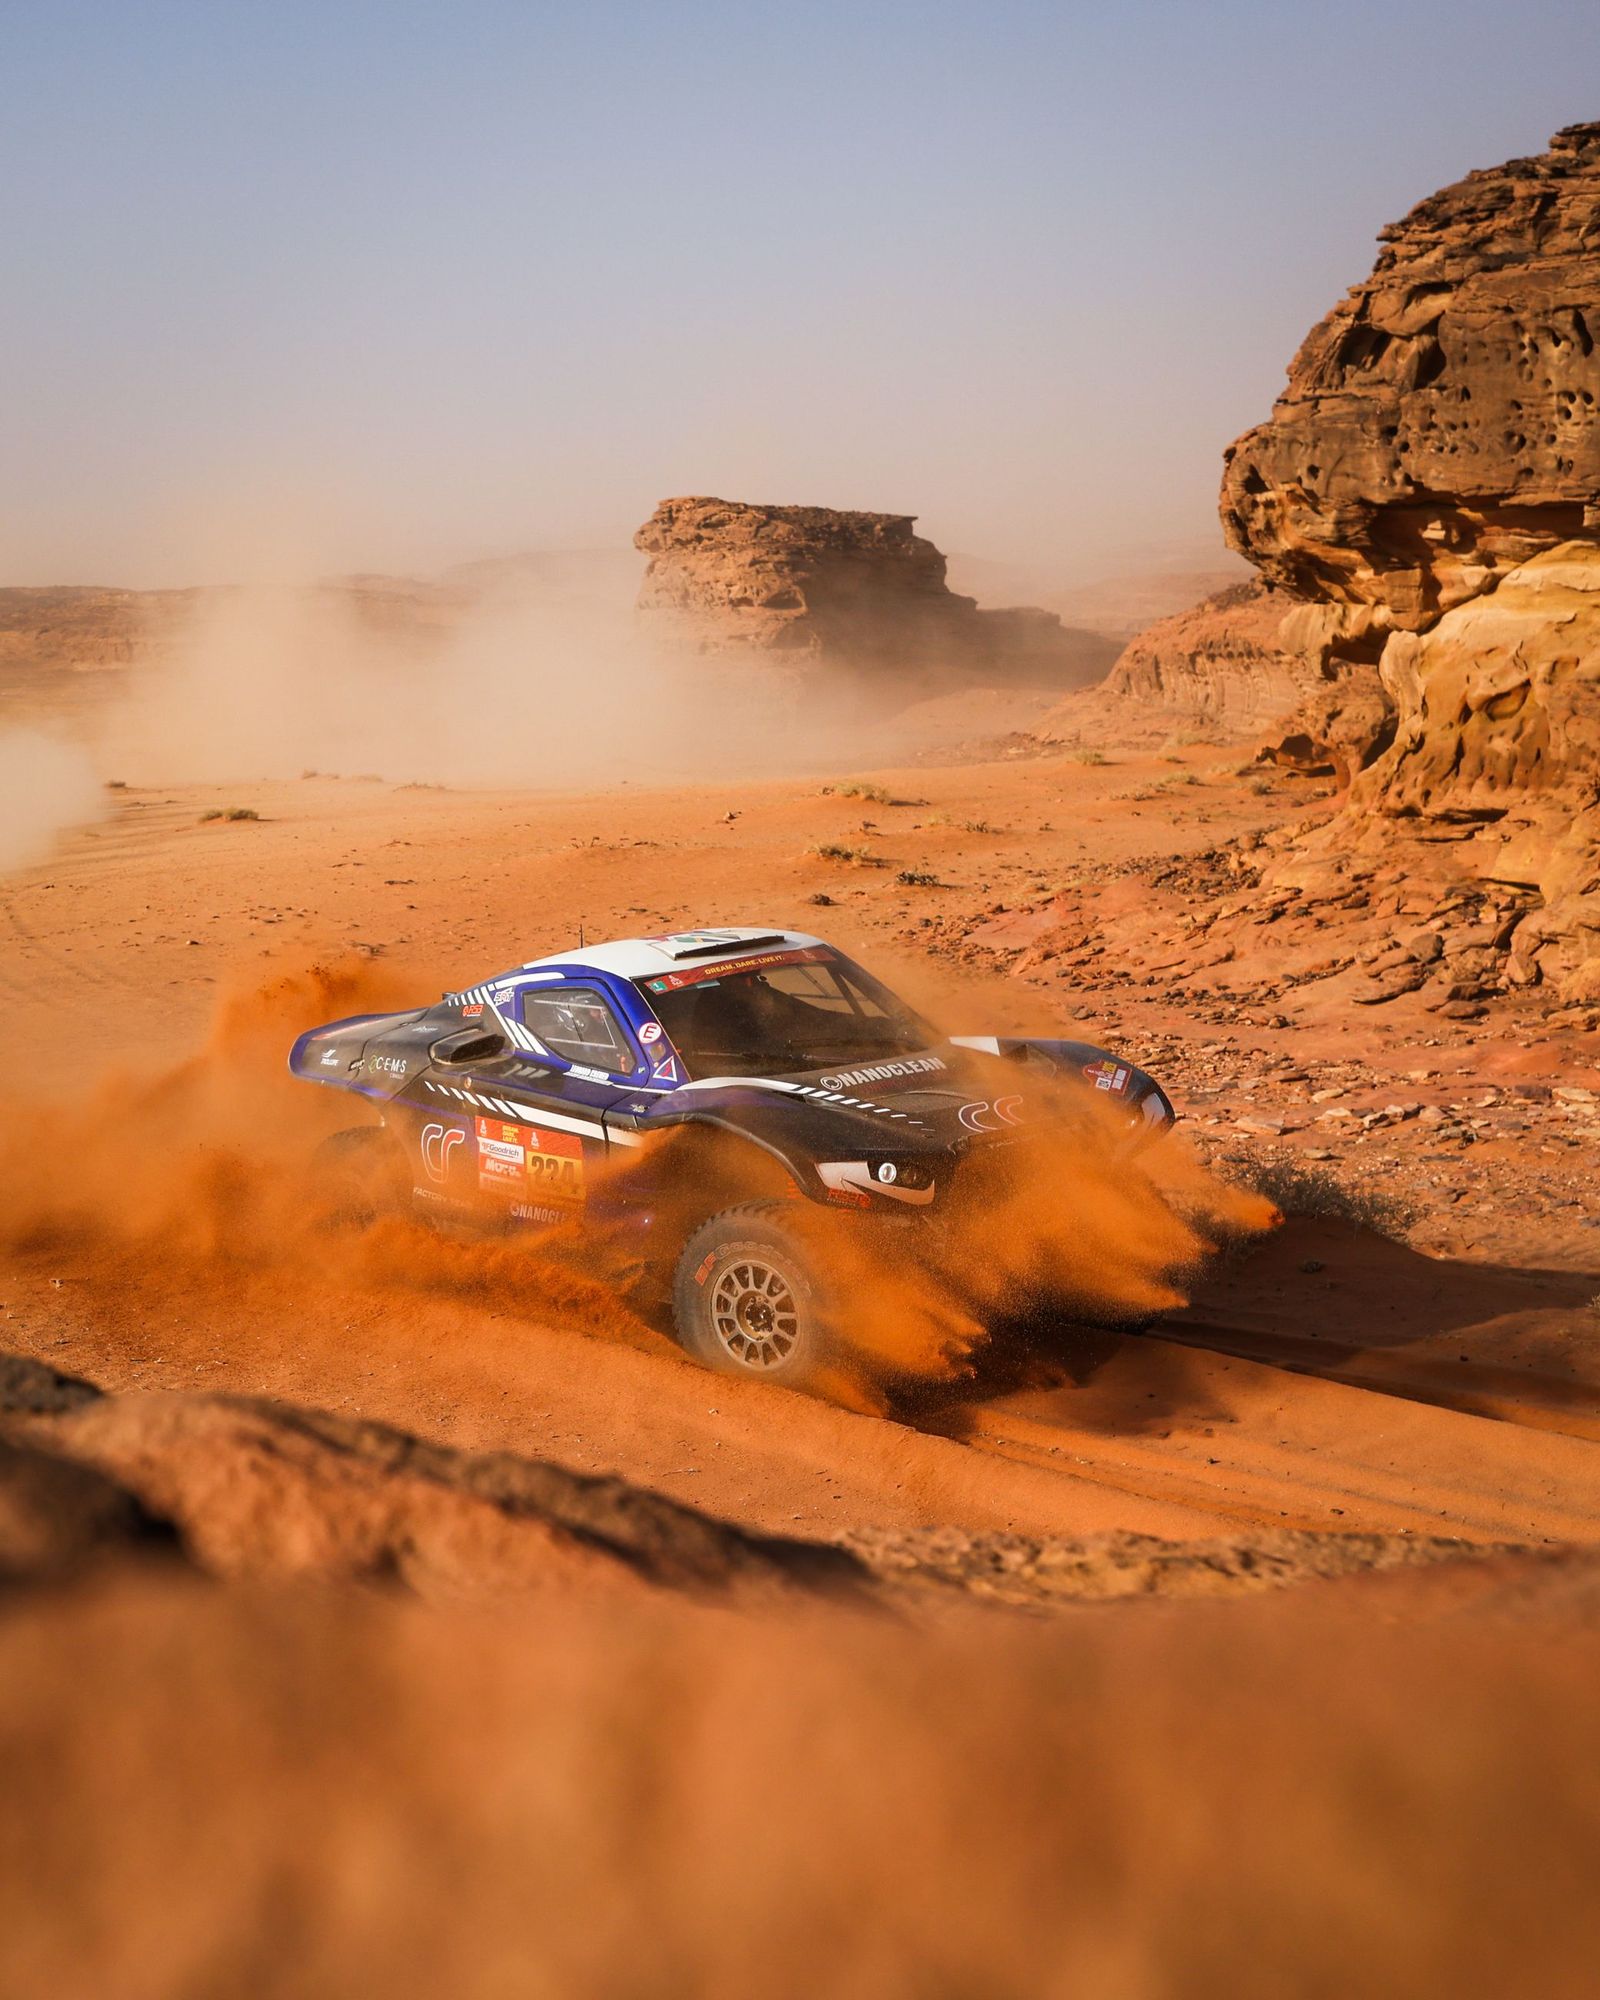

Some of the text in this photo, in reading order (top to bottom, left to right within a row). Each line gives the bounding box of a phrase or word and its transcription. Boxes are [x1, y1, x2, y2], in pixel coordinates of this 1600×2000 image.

[704, 963, 735, 975] DREAM.
[735, 959, 759, 969] DARE.
[758, 956, 775, 965] LIVE
[837, 1057, 947, 1087] NANOCLEAN
[531, 1155, 578, 1194] 224
